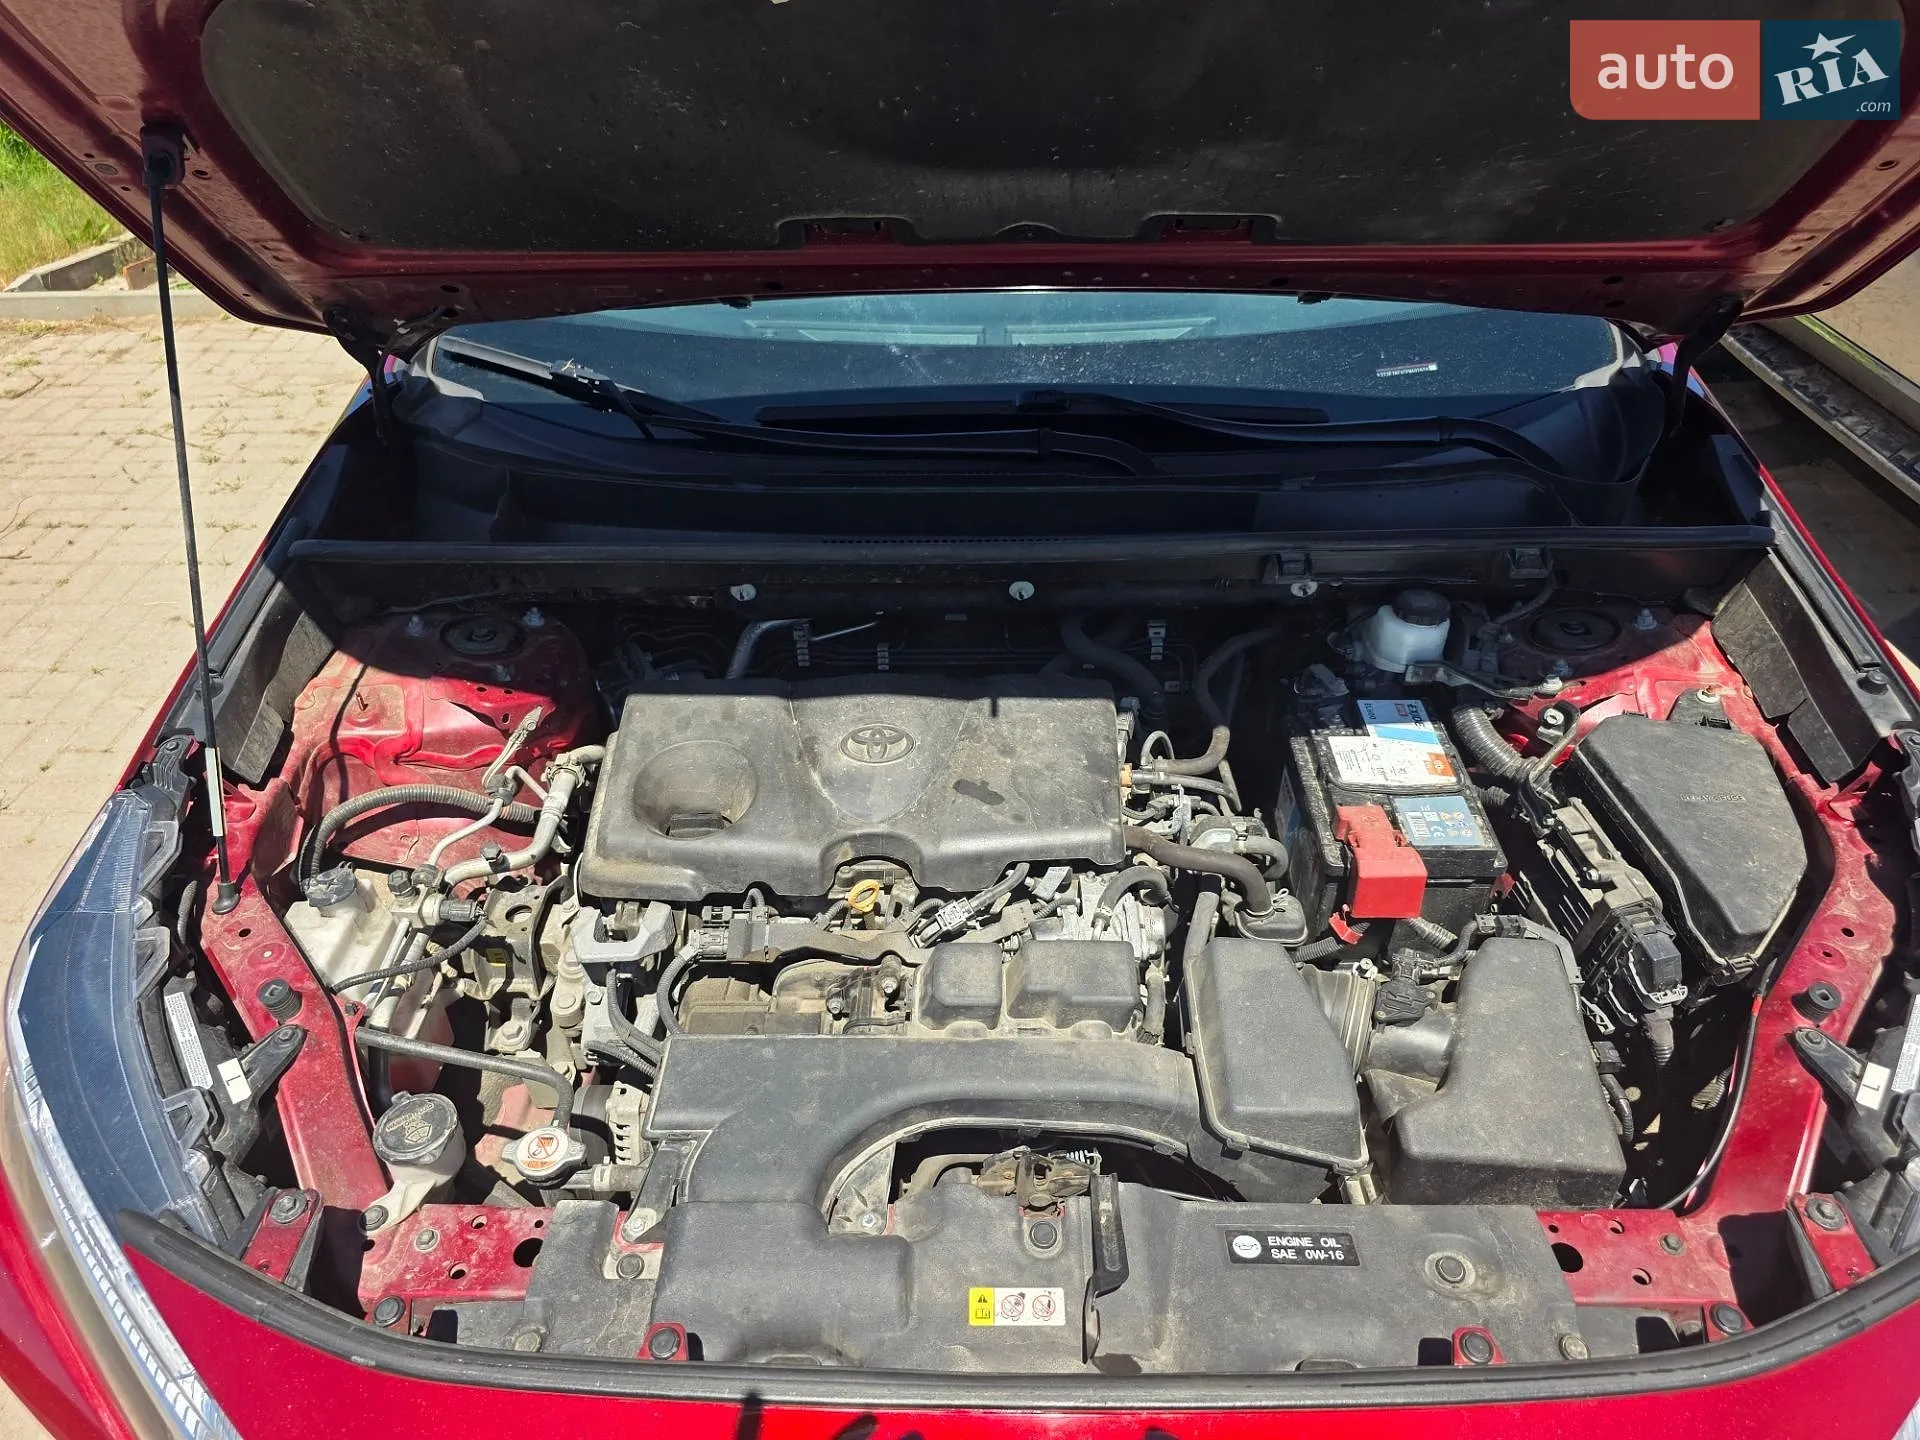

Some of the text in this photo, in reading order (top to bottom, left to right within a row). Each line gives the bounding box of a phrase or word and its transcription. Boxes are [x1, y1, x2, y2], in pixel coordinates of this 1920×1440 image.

[1407, 702, 1425, 728] EXIDE
[226, 1075, 241, 1086] L
[1267, 1236, 1342, 1248] ENGINE OIL
[1271, 1248, 1344, 1260] SAE 0W-16
